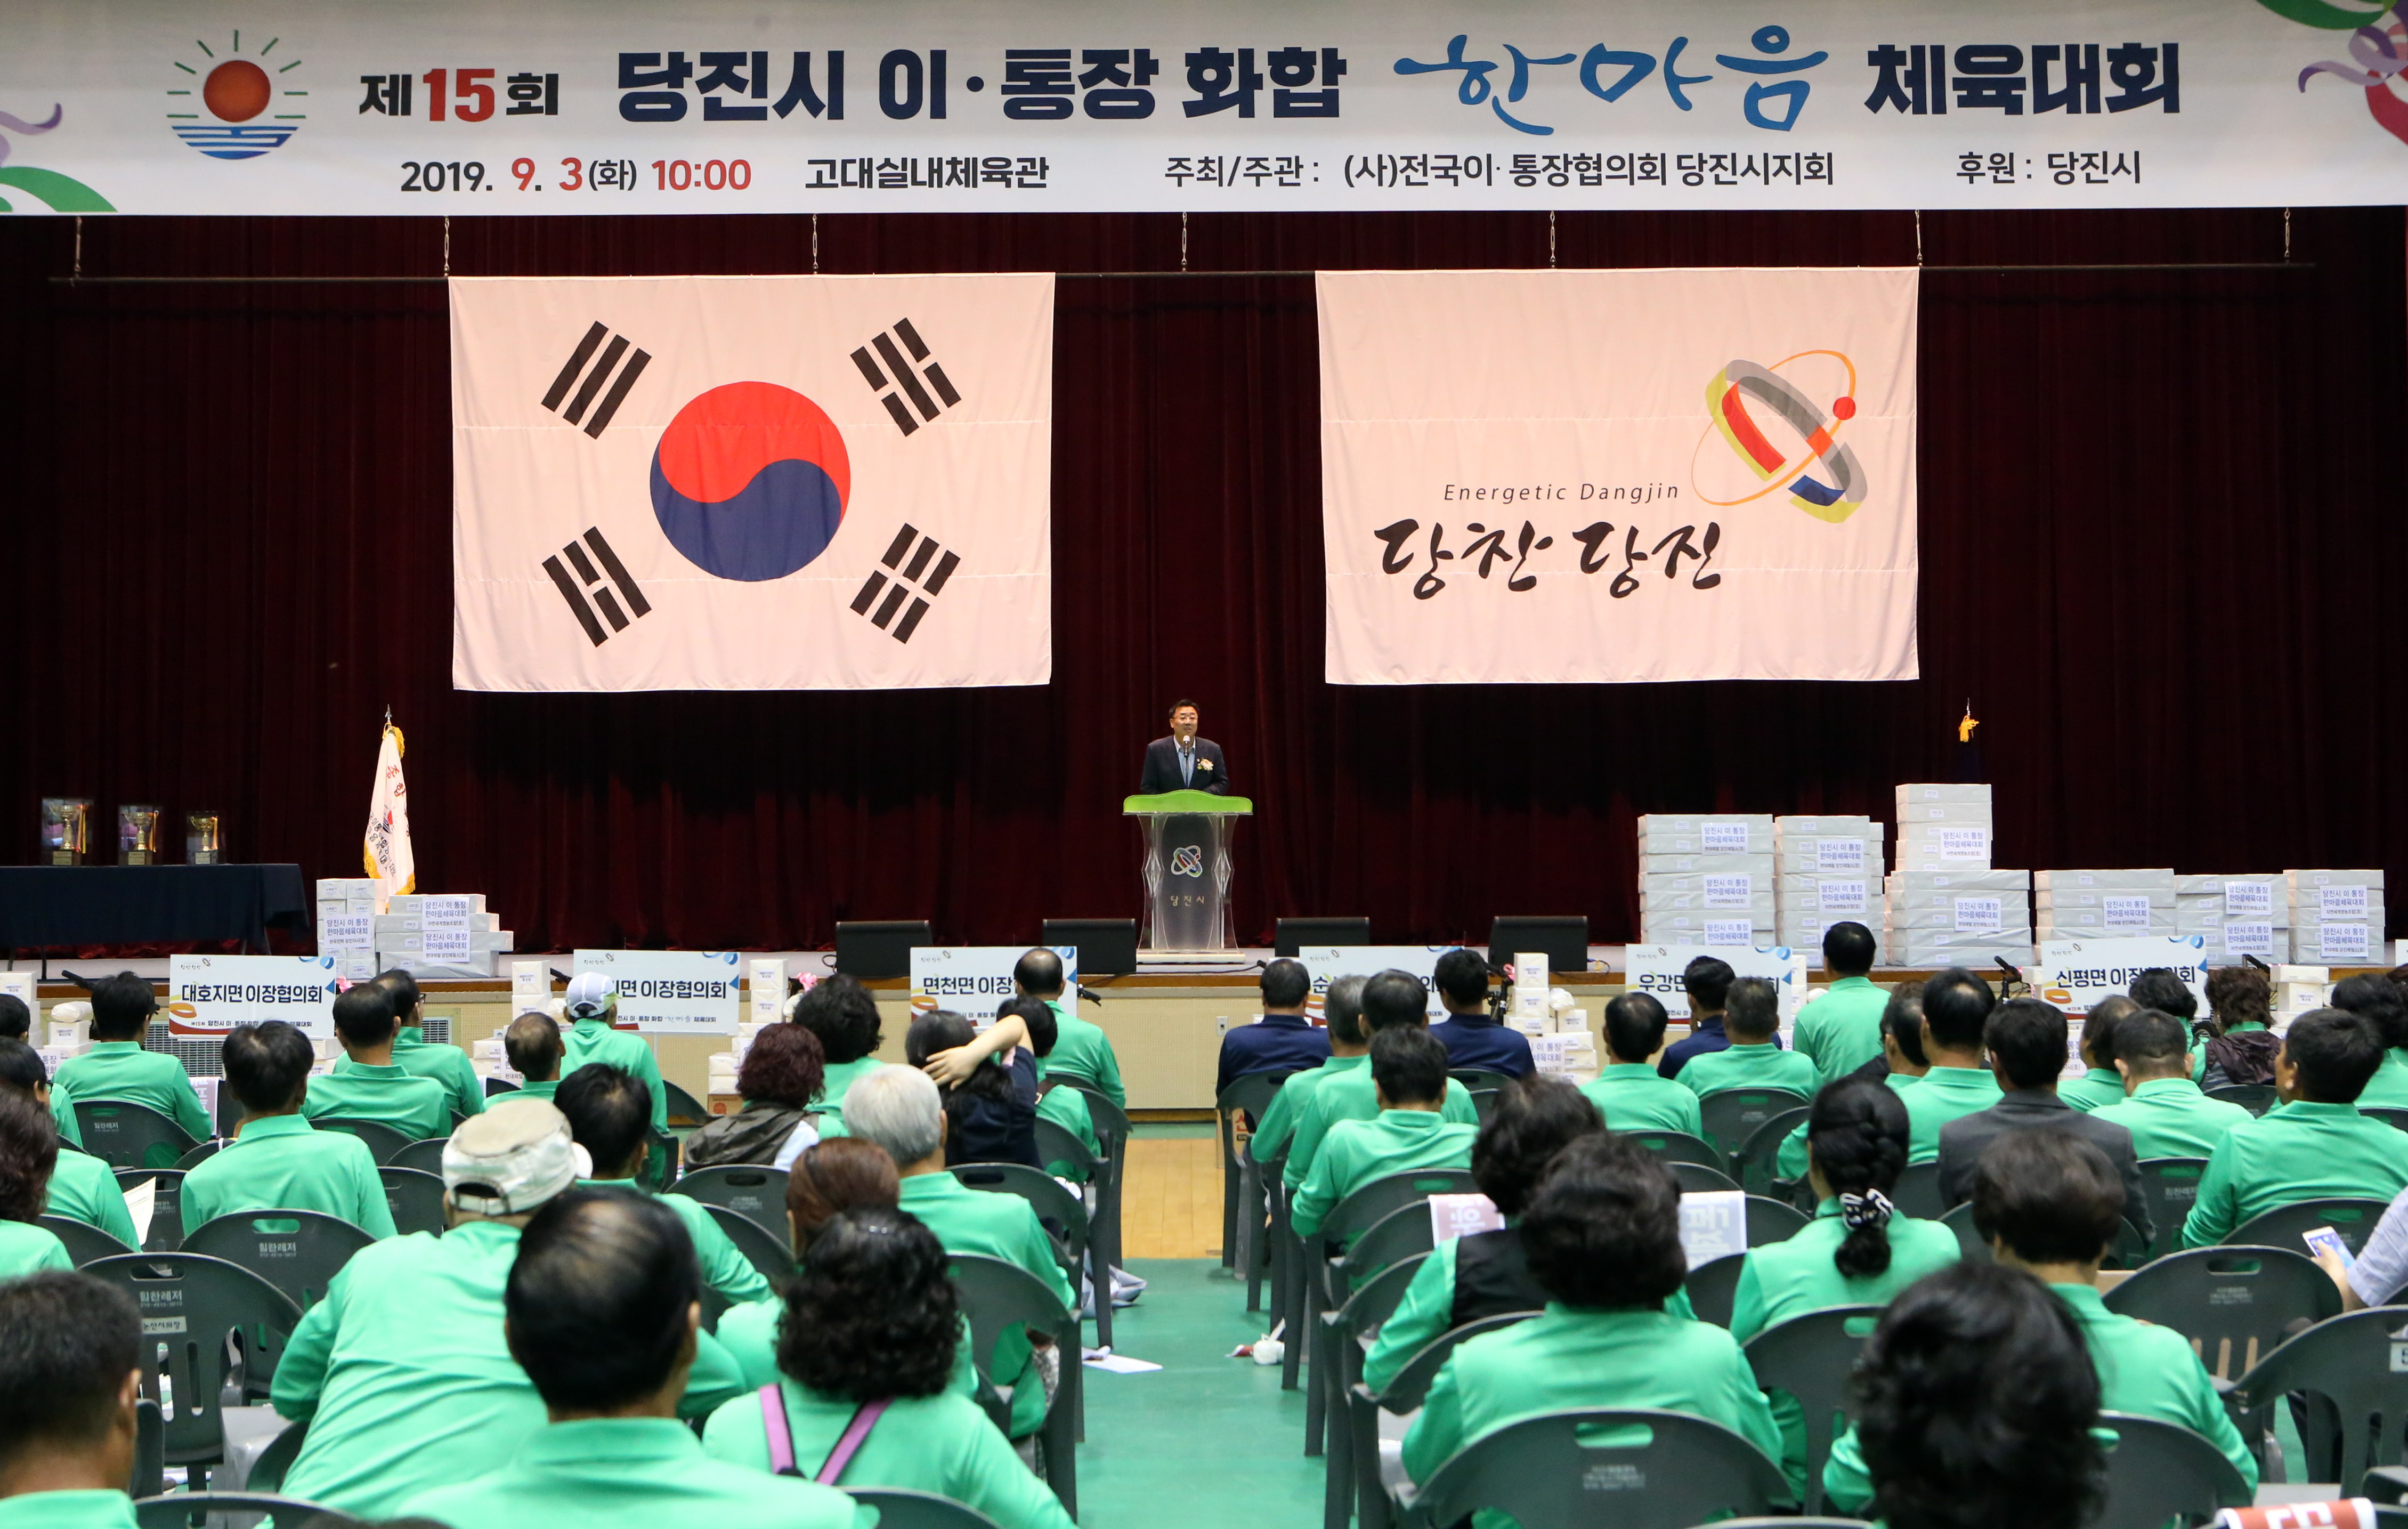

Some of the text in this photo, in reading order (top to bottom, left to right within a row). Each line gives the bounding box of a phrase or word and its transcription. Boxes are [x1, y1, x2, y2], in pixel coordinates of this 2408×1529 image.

[359, 68, 559, 123] 제15회
[618, 50, 845, 122] 당진시
[1182, 47, 1347, 119] 화합
[1393, 25, 1829, 135] 한마음
[1863, 42, 2180, 116] 체육대회
[401, 161, 493, 192] 2019.
[512, 157, 541, 192] 9.
[651, 159, 751, 191] 10:00
[805, 157, 1049, 189] 고대실내체육관
[1677, 152, 1833, 187] 당진시지회
[2048, 150, 2140, 185] 당진시
[1444, 482, 1678, 505] Energetic Dangjin
[1374, 519, 1721, 600] 당찬 당진
[1171, 895, 1204, 906] 당진시
[327, 918, 368, 927] 당진시 이 통장
[327, 927, 368, 936] 한마음체육대회
[923, 976, 975, 995] 면천면
[2056, 969, 2107, 988] 신평면
[182, 984, 322, 1004] 대호지면 이장협의회
[640, 980, 727, 999] 이장협의회
